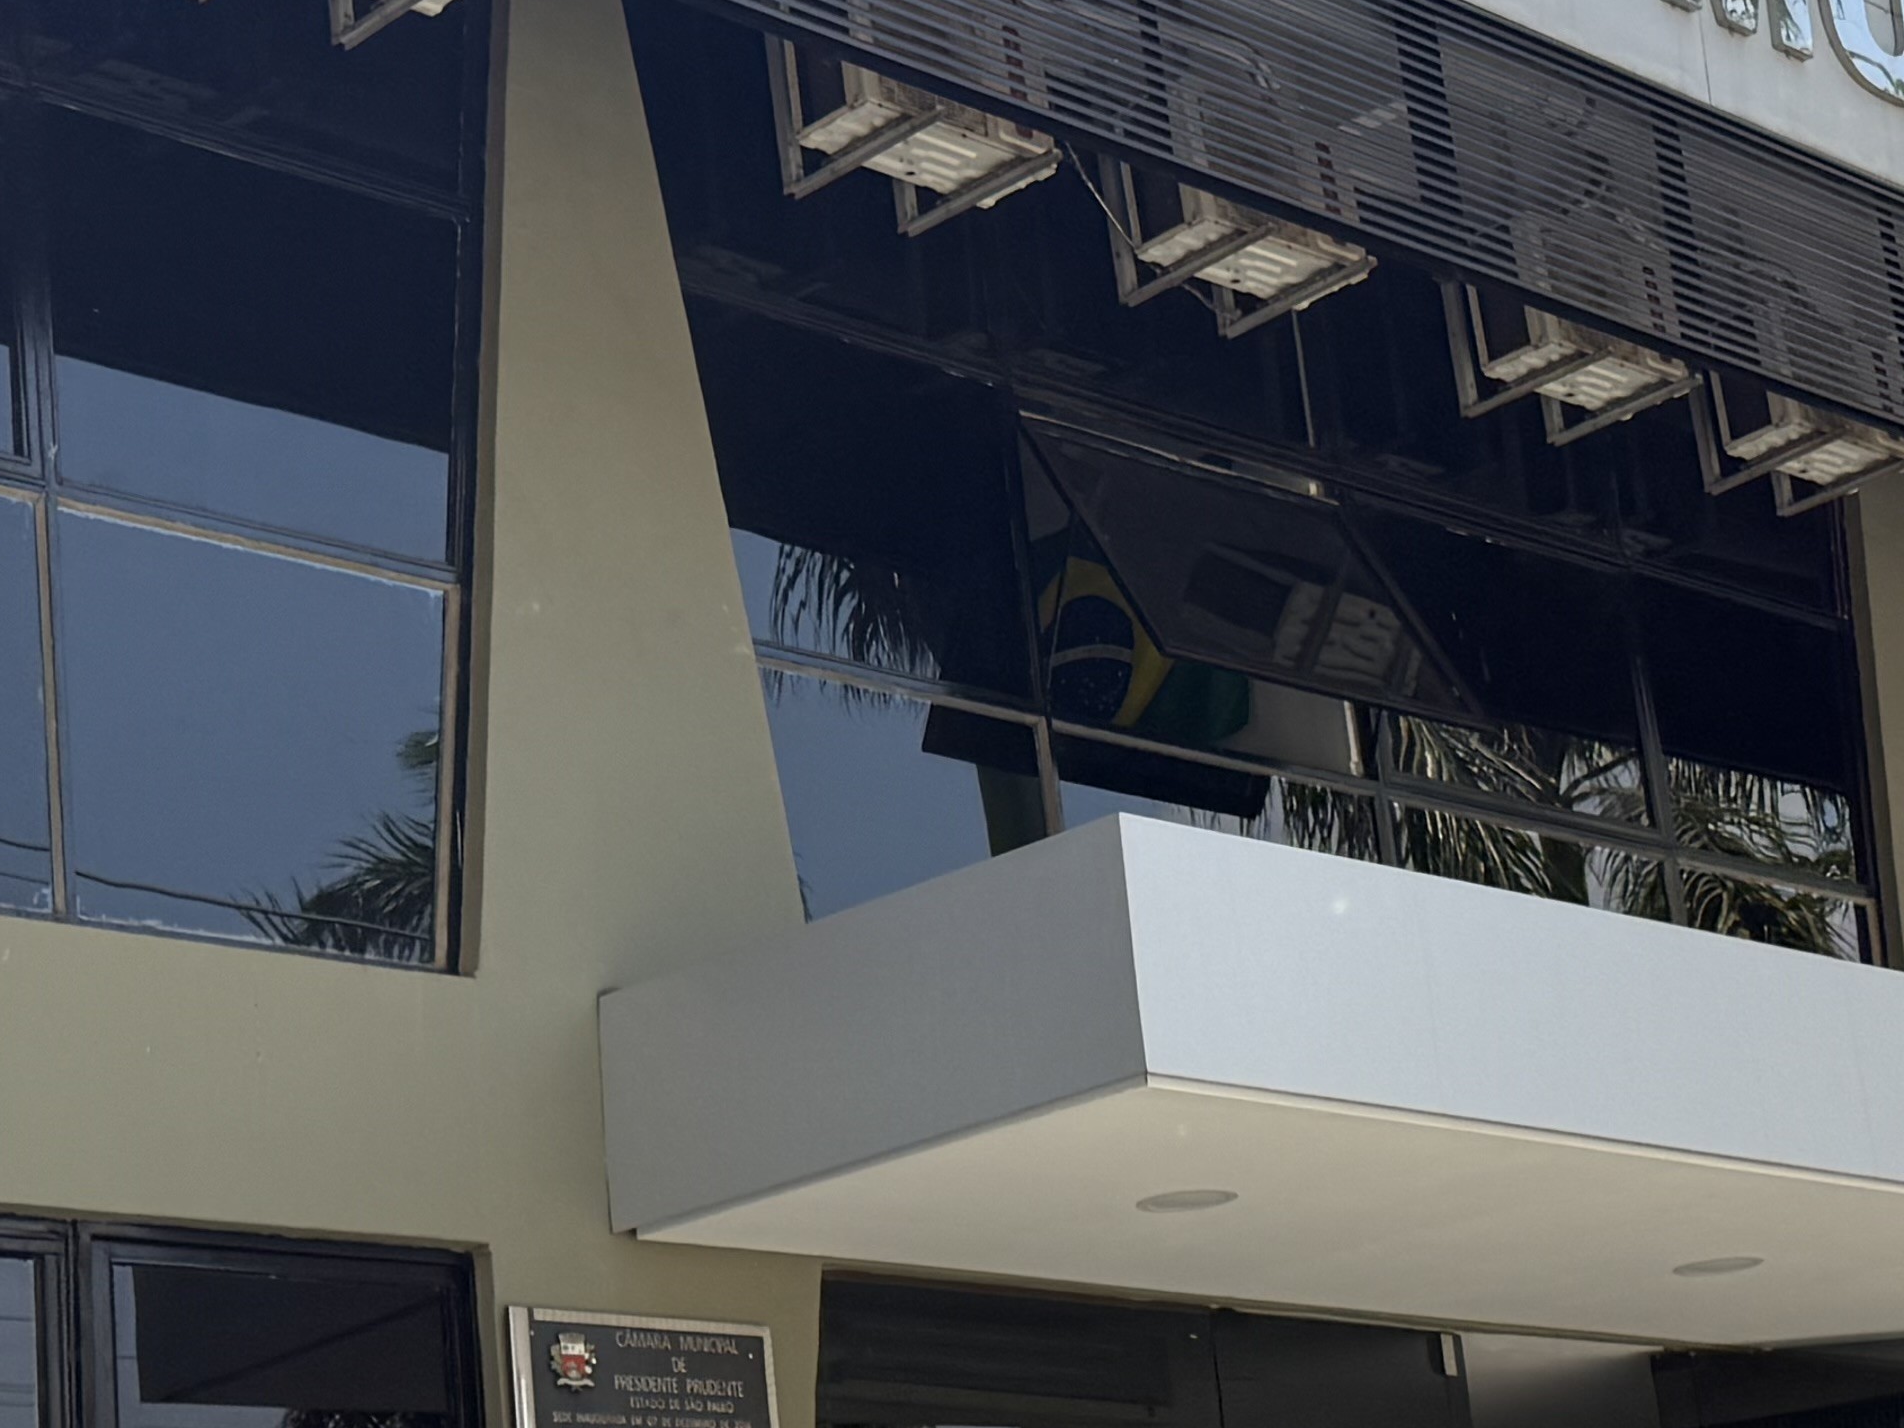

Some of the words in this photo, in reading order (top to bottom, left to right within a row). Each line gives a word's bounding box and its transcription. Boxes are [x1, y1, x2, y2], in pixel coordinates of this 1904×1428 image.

[616, 1329, 672, 1351] CÂMARA
[680, 1335, 739, 1355] MUNICIPAL
[671, 1356, 688, 1373] DE
[614, 1374, 678, 1394] PRESIDENTE
[686, 1378, 745, 1398] PRUDENTE
